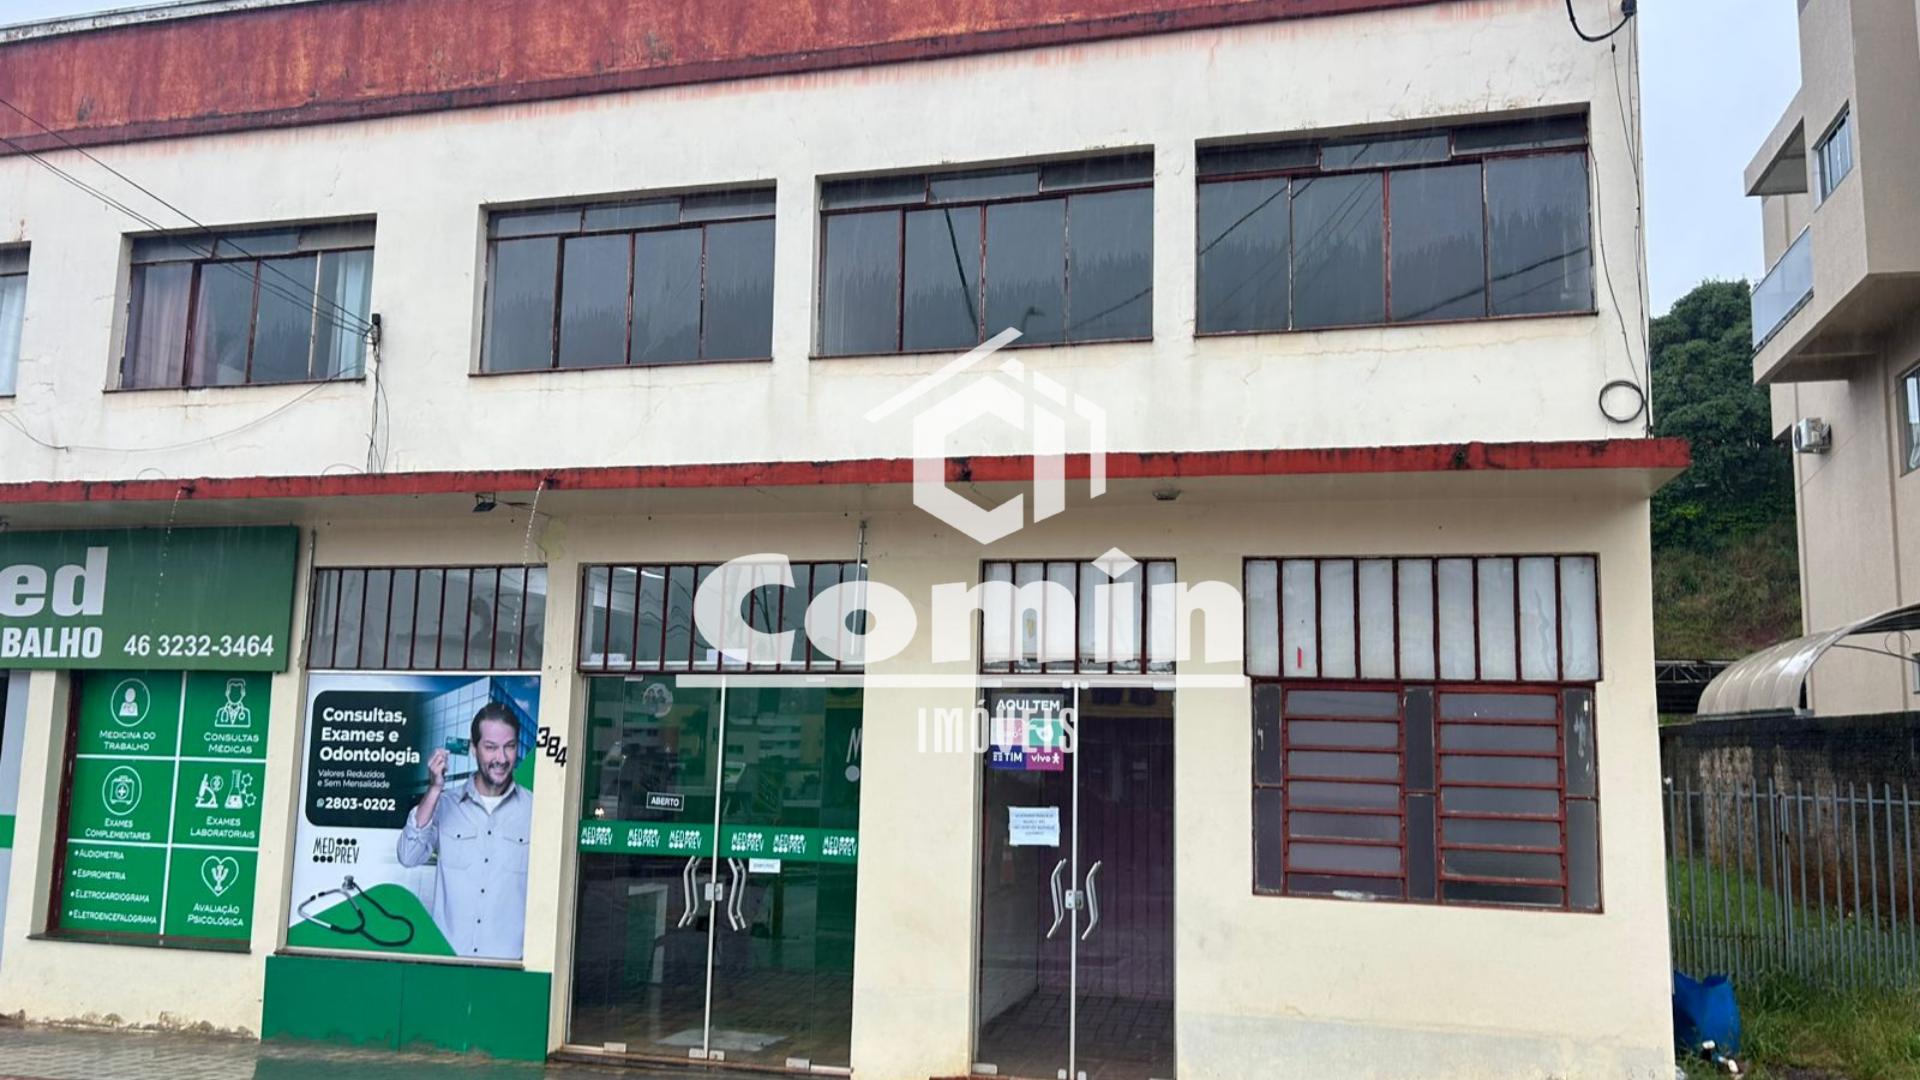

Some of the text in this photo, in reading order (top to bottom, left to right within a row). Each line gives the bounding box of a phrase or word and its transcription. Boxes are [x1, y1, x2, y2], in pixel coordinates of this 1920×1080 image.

[1, 627, 103, 658] BALHO
[124, 635, 274, 657] 46 3232-3464
[996, 699, 1060, 711] AQUI TEM
[323, 707, 407, 726] Consultas,
[99, 730, 156, 740] MEDICINA DO
[204, 732, 259, 742] CONSULTAS
[321, 727, 399, 742] Exames e
[104, 741, 149, 750] TRABALHO
[536, 727, 567, 767] 384
[319, 747, 420, 766] Odontologia
[1004, 752, 1023, 762] TIM
[1031, 752, 1051, 763] vivo
[318, 769, 385, 778] Valores Reduzidos
[324, 779, 341, 787] Sem
[343, 779, 390, 789] Mensalidade
[325, 797, 396, 811] 2803-0202
[651, 796, 680, 807] ABERTO
[105, 818, 133, 828] EXAMES
[206, 816, 241, 826] EXAMES
[85, 828, 151, 840] COMPLEMENTARES
[190, 828, 255, 839] LABORATORIAIS
[79, 849, 124, 860] AUDIOMETRIA
[313, 837, 360, 864] MED PREV
[77, 869, 126, 880] ESPIROMETRIA
[75, 889, 149, 903] ELETROCARDIOGRAMA
[193, 903, 240, 915] AVALIAÇÃO
[73, 909, 157, 924] ELETROENCEFALOGRAMA
[187, 914, 244, 926] PSICOLÓGICA
